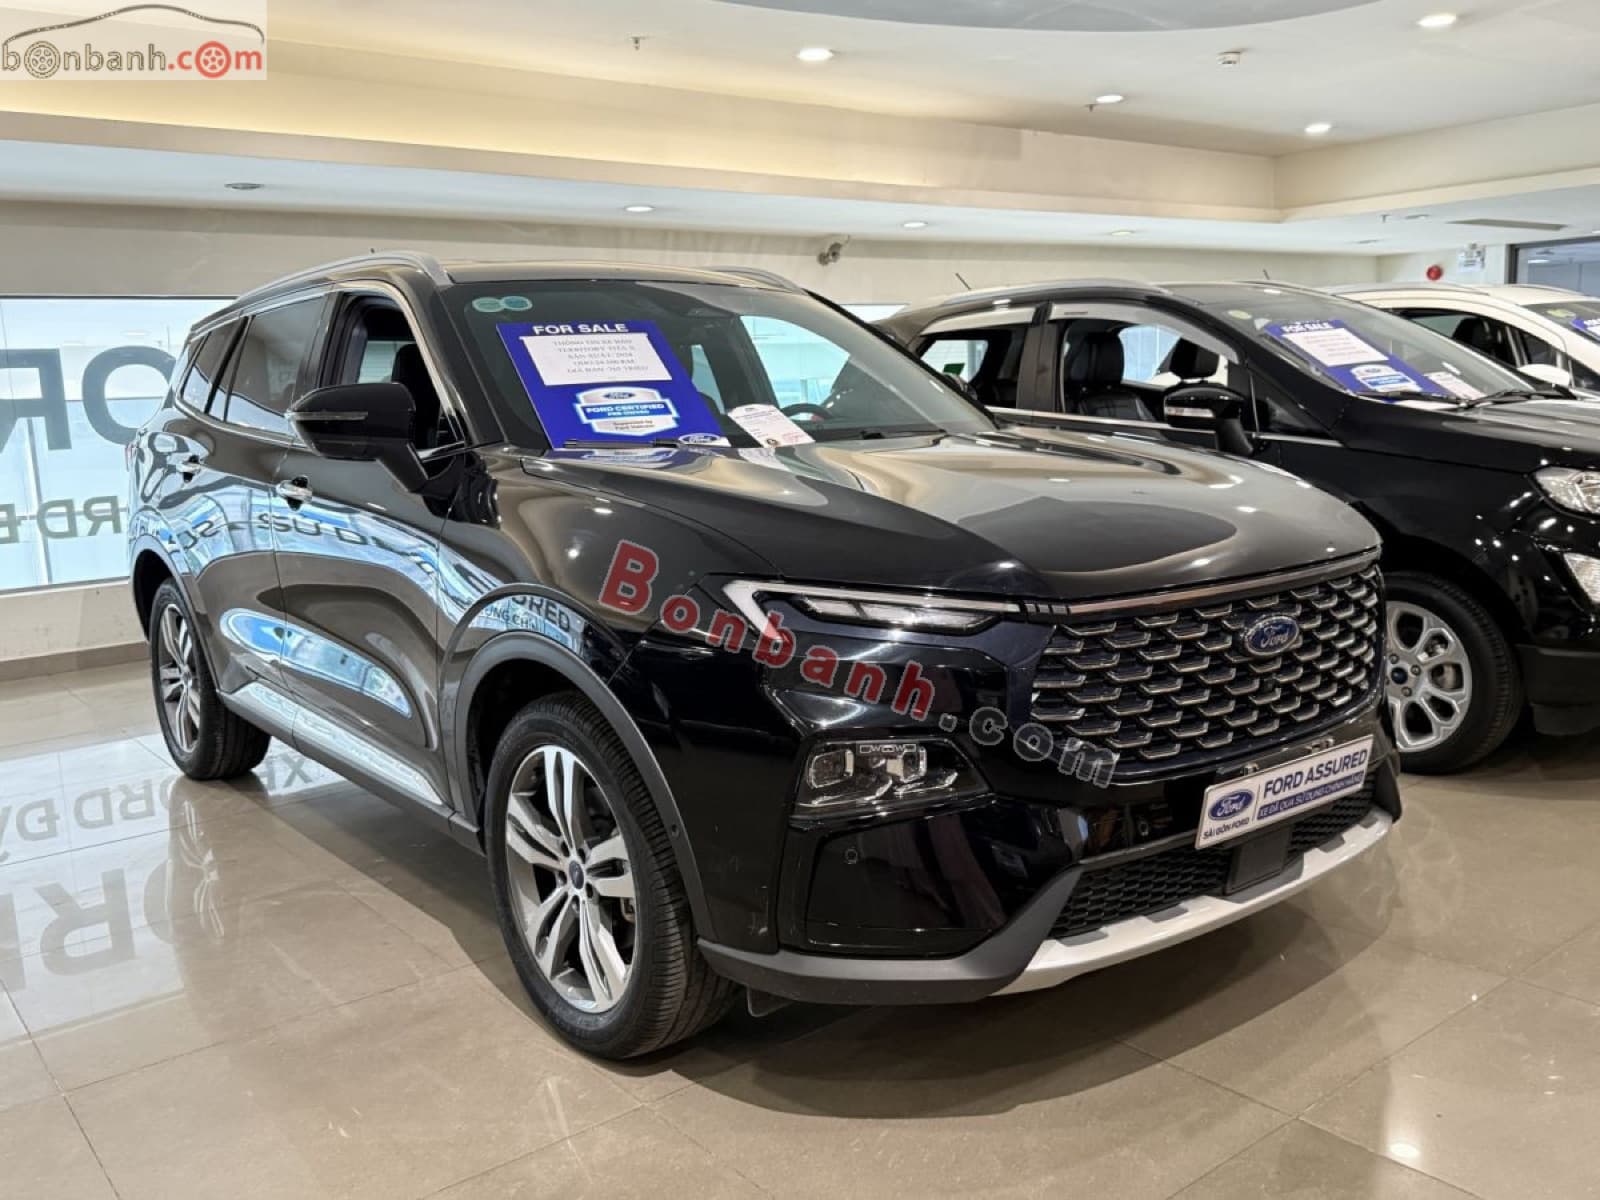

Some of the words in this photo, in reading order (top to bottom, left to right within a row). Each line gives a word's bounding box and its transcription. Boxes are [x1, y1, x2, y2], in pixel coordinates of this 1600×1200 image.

[533, 324, 574, 335] FOR
[577, 323, 629, 334] SALE
[586, 406, 613, 414] FORD
[614, 403, 665, 412] CERTIFIED
[1264, 771, 1304, 798] FORD
[1304, 749, 1368, 786] ASSURED
[1217, 794, 1248, 817] Ford
